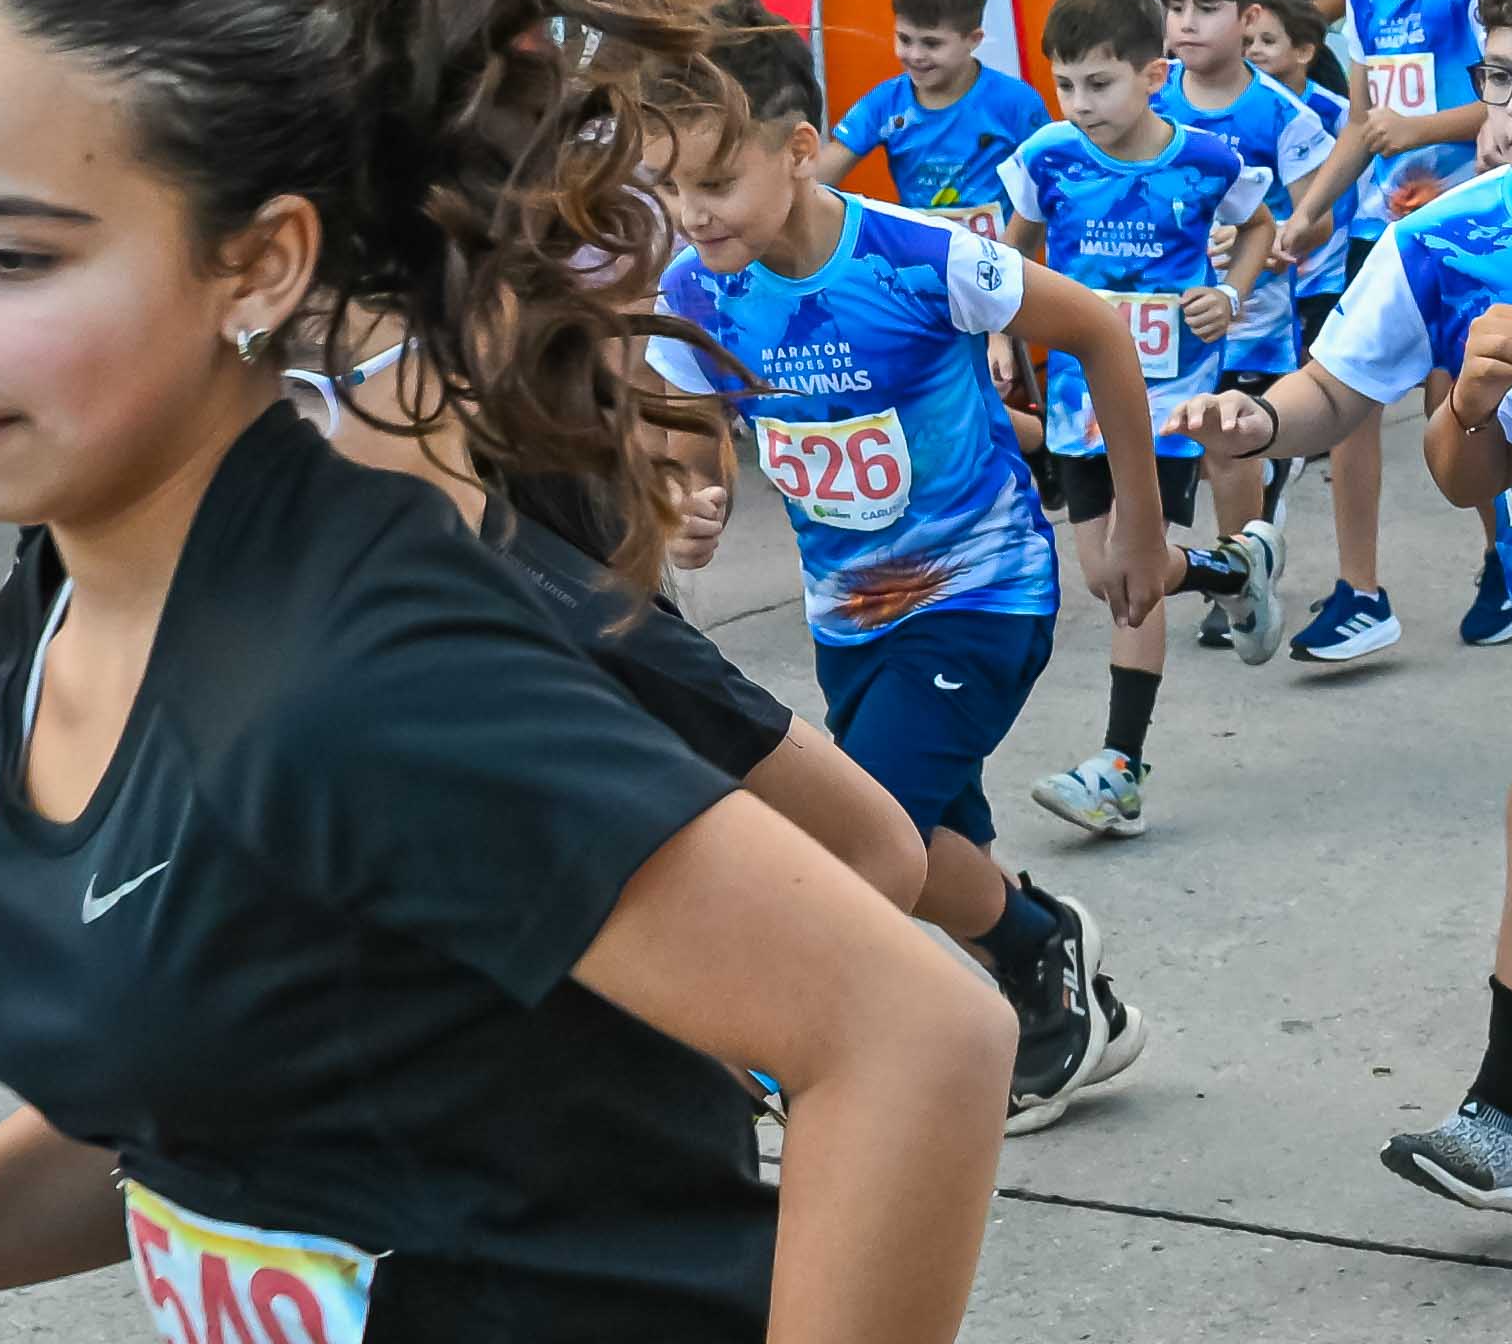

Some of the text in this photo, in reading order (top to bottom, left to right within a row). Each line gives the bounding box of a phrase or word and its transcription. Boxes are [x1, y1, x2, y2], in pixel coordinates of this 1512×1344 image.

[1080, 239, 1164, 258] MALVINAS
[832, 356, 854, 369] DE
[766, 427, 901, 502] 526
